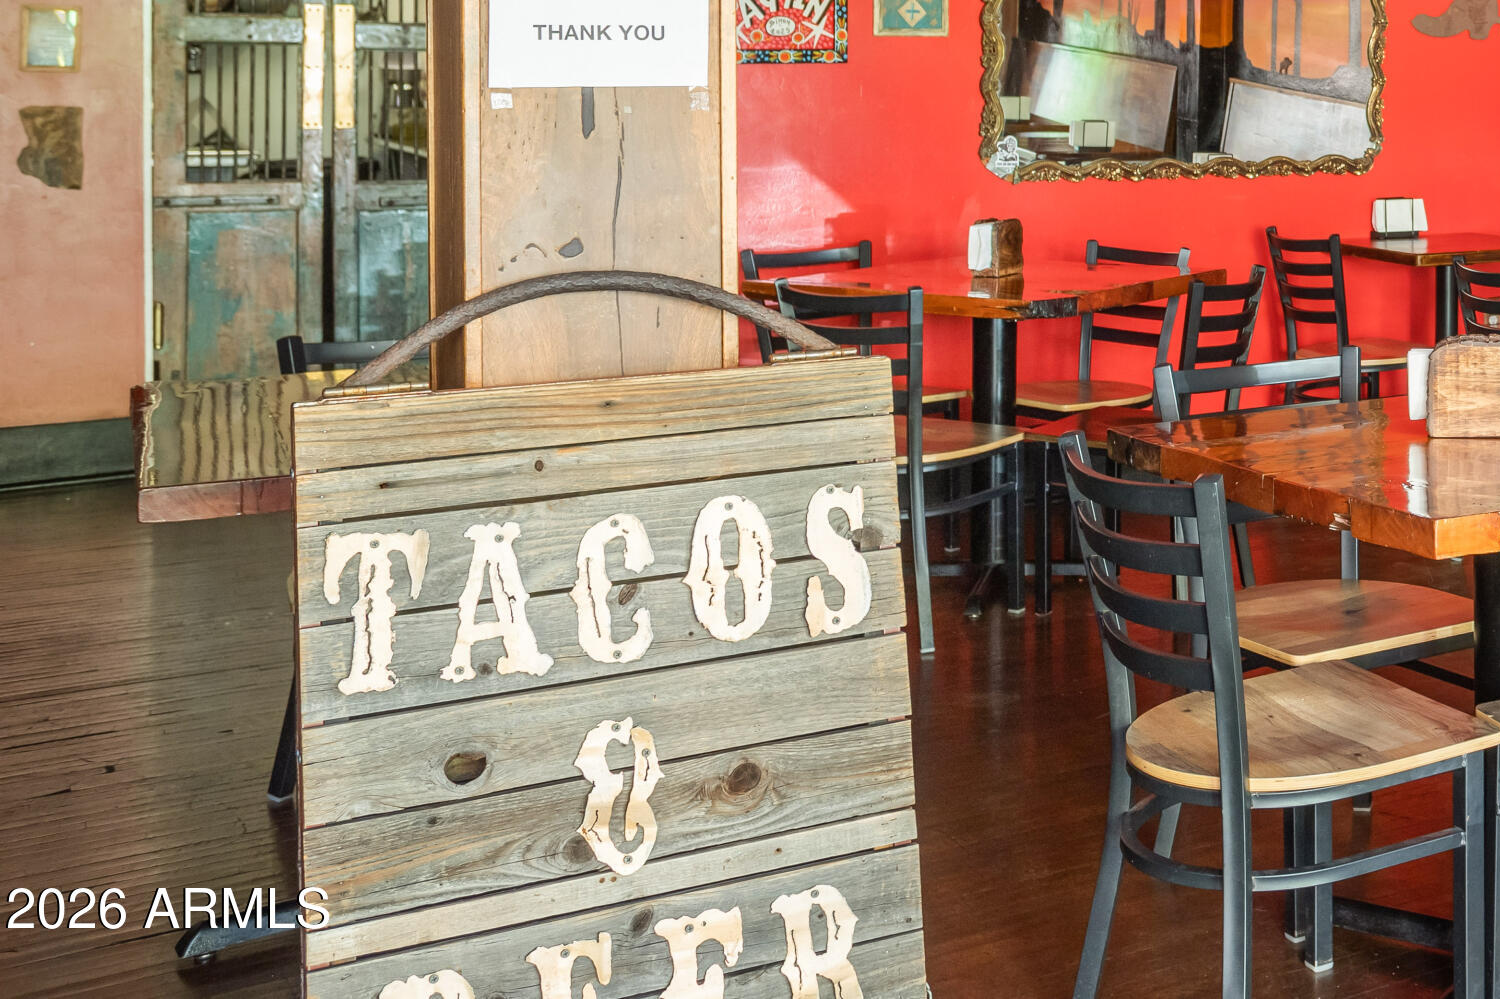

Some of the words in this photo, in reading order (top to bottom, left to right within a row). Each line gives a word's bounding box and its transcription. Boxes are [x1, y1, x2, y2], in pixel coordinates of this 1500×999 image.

[533, 24, 613, 41] THANK
[618, 24, 666, 41] YOU
[323, 483, 872, 696] TACOS
[574, 716, 666, 876] &
[378, 883, 864, 999] ER
